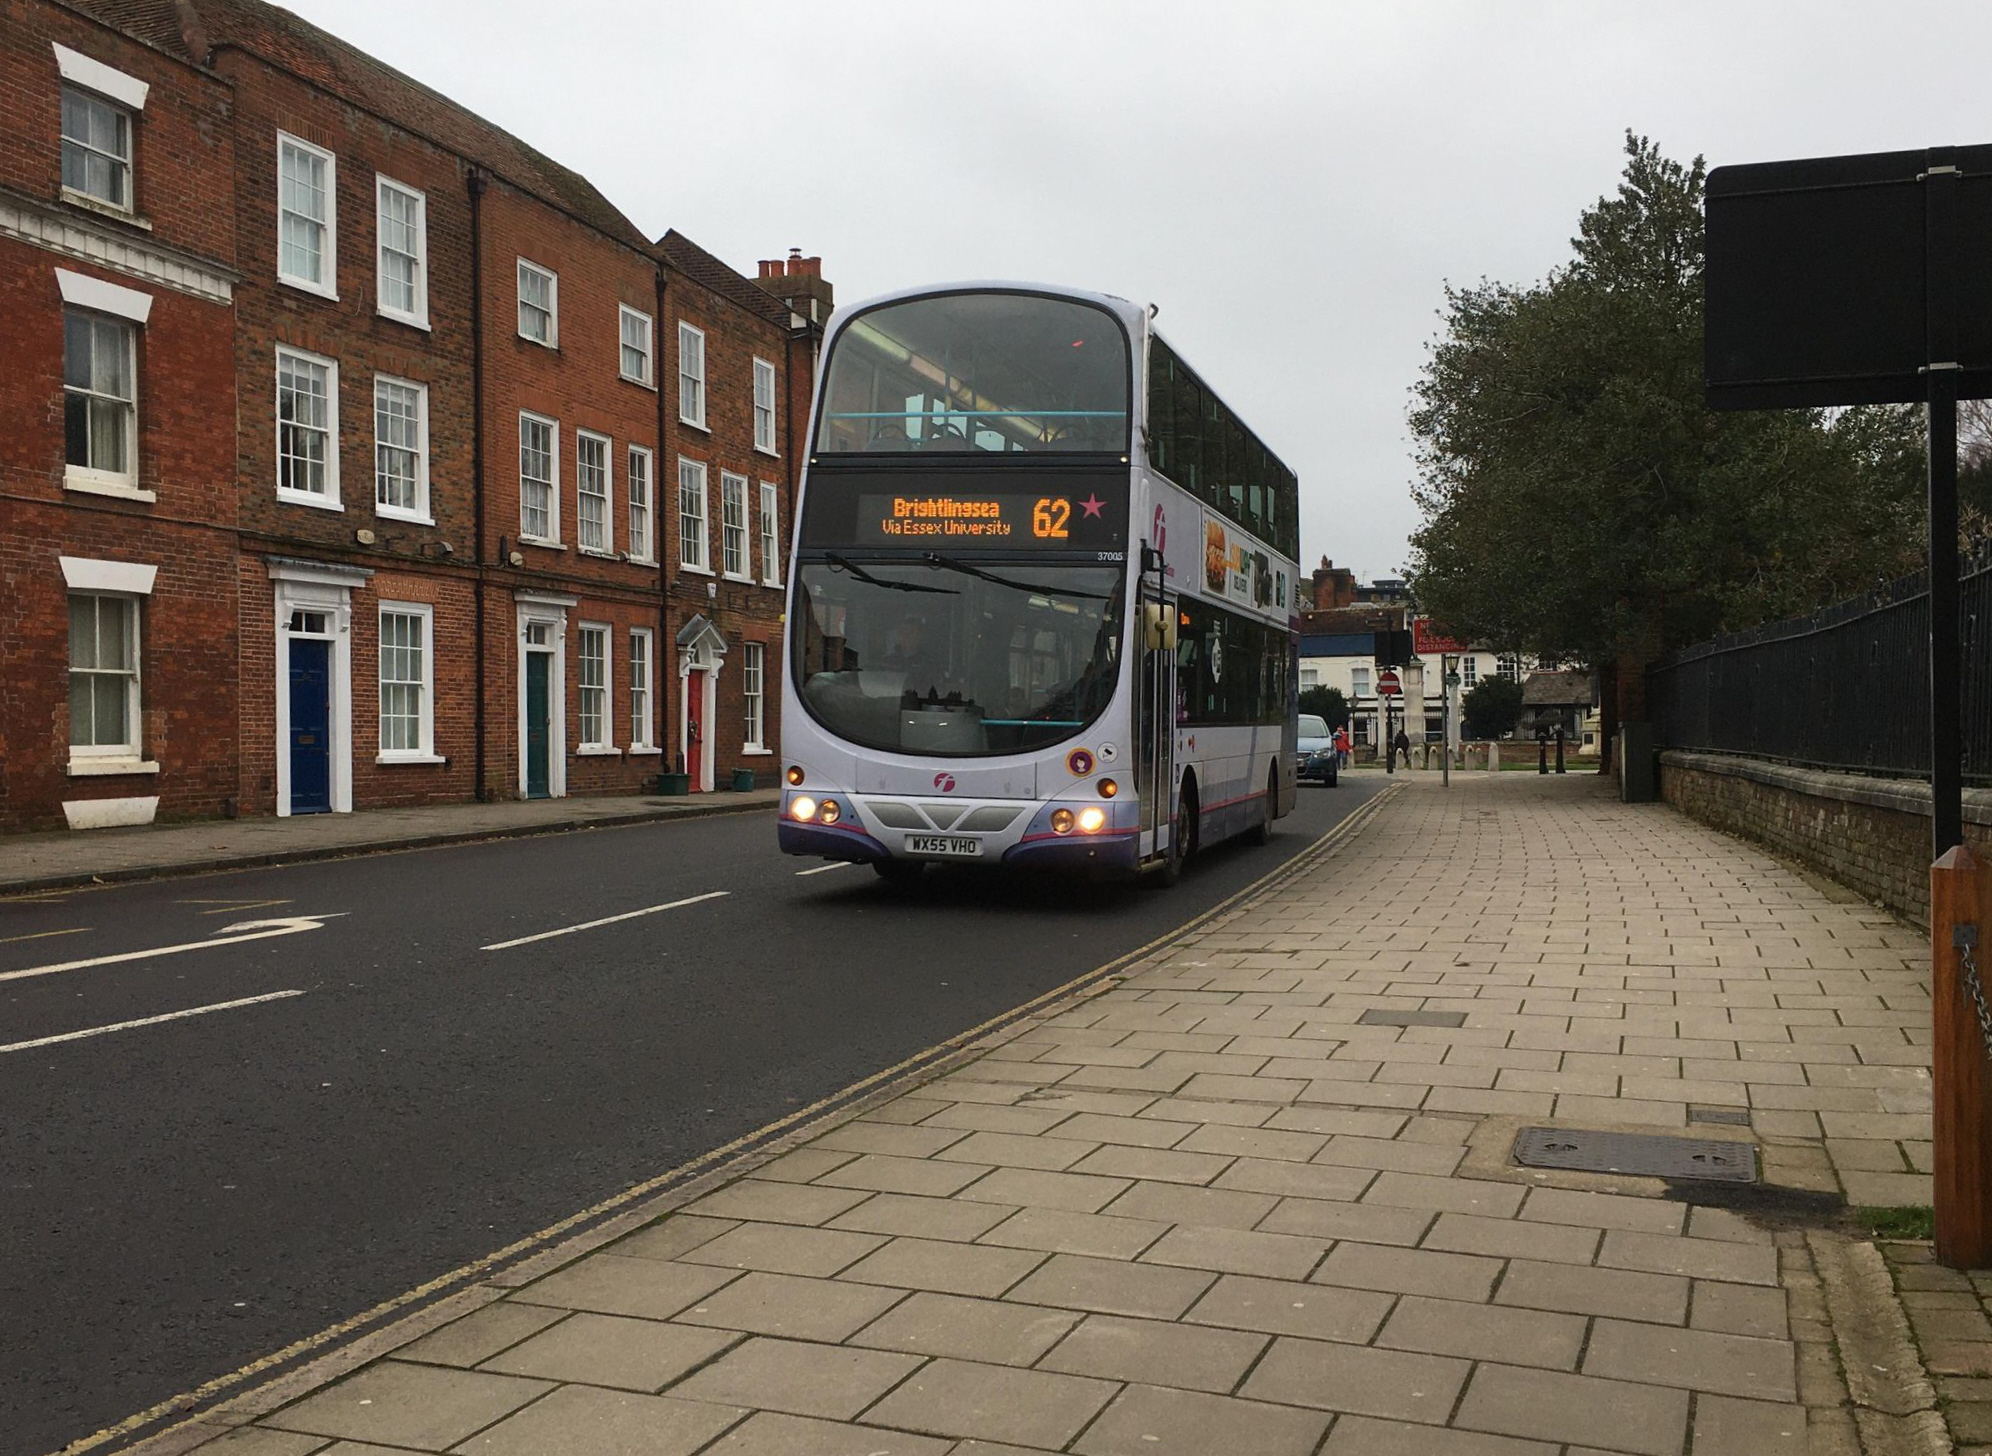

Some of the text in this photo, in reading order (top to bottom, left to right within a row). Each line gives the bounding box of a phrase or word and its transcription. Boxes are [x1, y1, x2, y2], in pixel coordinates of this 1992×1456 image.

[894, 498, 1000, 517] Brightlingsea
[1033, 498, 1071, 537] 62
[882, 519, 1011, 535] Via Essex University
[1097, 551, 1123, 561] 37005
[912, 837, 976, 853] WX55 VHO
